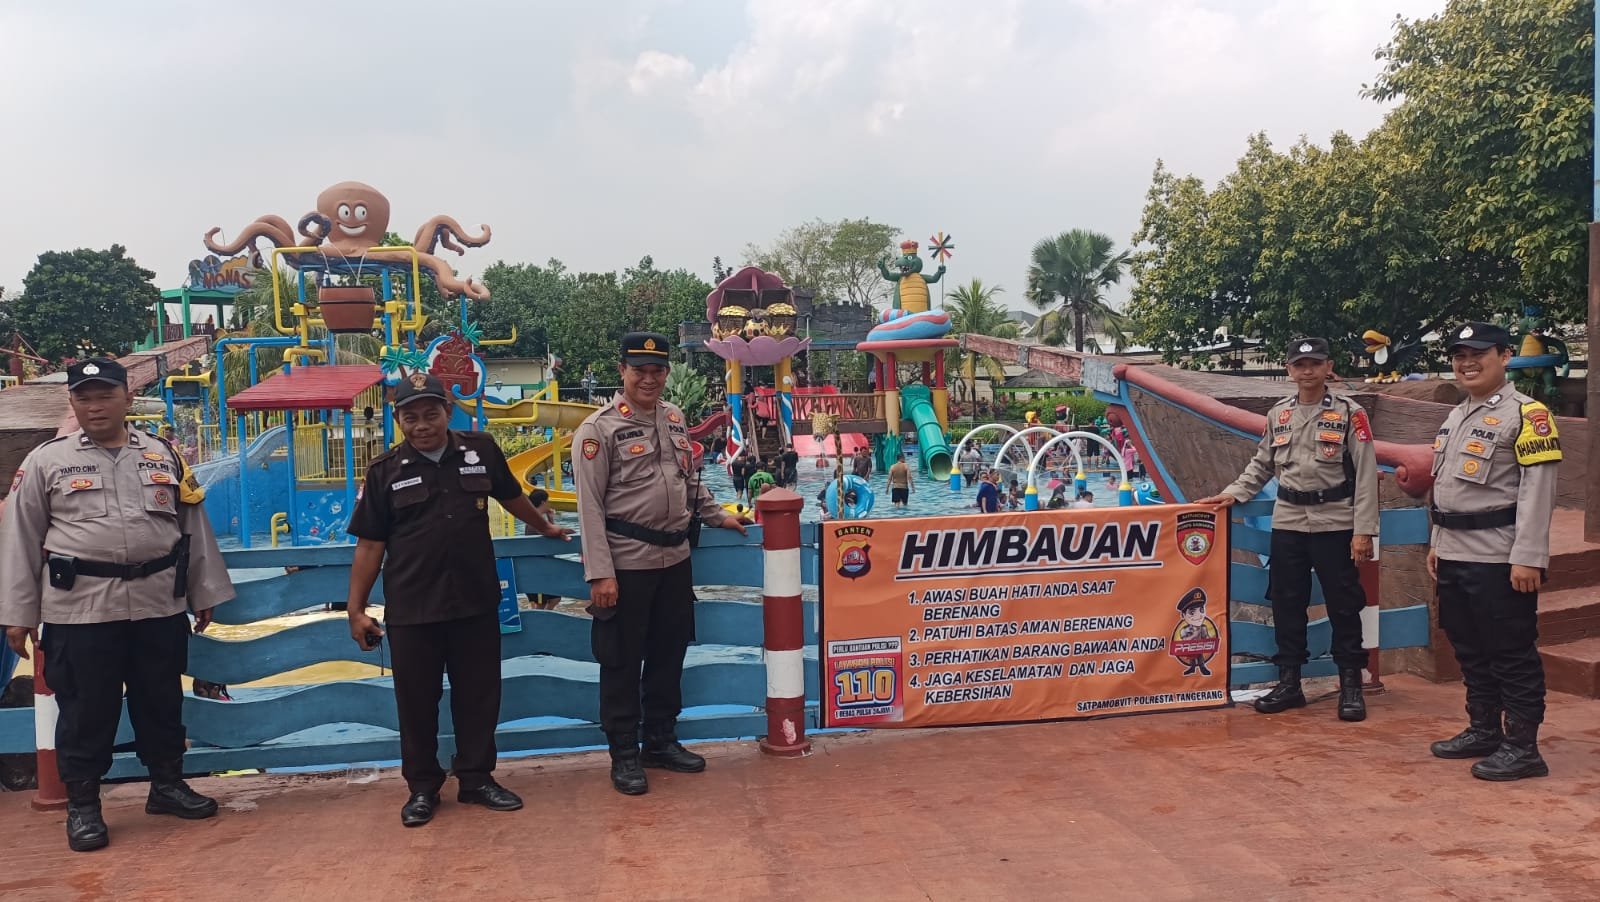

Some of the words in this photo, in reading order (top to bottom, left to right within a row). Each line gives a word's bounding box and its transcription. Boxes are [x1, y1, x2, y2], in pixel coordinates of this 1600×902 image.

[203, 268, 252, 289] MONAS
[1318, 421, 1346, 431] POLRI
[1470, 428, 1496, 441] POLRI
[138, 462, 169, 472] POLRI
[838, 526, 872, 537] BANTEN
[900, 523, 1160, 570] HIMBAUAN
[909, 591, 919, 604] 1.
[923, 589, 967, 604] AWASI
[969, 587, 1009, 600] BUAH
[1011, 584, 1041, 595] HATI
[1043, 582, 1078, 597] ANDA
[1081, 580, 1115, 595] SAAT
[923, 604, 1001, 622] BERENANG
[909, 628, 920, 642] 2.
[923, 625, 972, 641] PATUHI
[975, 622, 1018, 637] BATAS
[1020, 620, 1061, 634] AMAN
[1063, 615, 1133, 632] BERENANG
[909, 653, 920, 667] 3.
[924, 647, 1009, 665] PERHATIKAN
[1012, 643, 1070, 658] BARANG
[1073, 639, 1128, 655] BAWAAN
[1130, 637, 1166, 652] ANDA
[909, 675, 920, 687] 4.
[924, 672, 962, 687] JAGA
[965, 664, 1063, 683] KESELAMATAN
[1069, 662, 1096, 676] DAN
[1098, 660, 1135, 674] JAGA
[835, 670, 896, 707] 110
[924, 684, 1012, 704] KEBERSIHAN
[1077, 697, 1132, 711] SATPAMOBVIT
[1134, 693, 1174, 705] POLRESTA
[1176, 689, 1223, 701] TANGERANG
